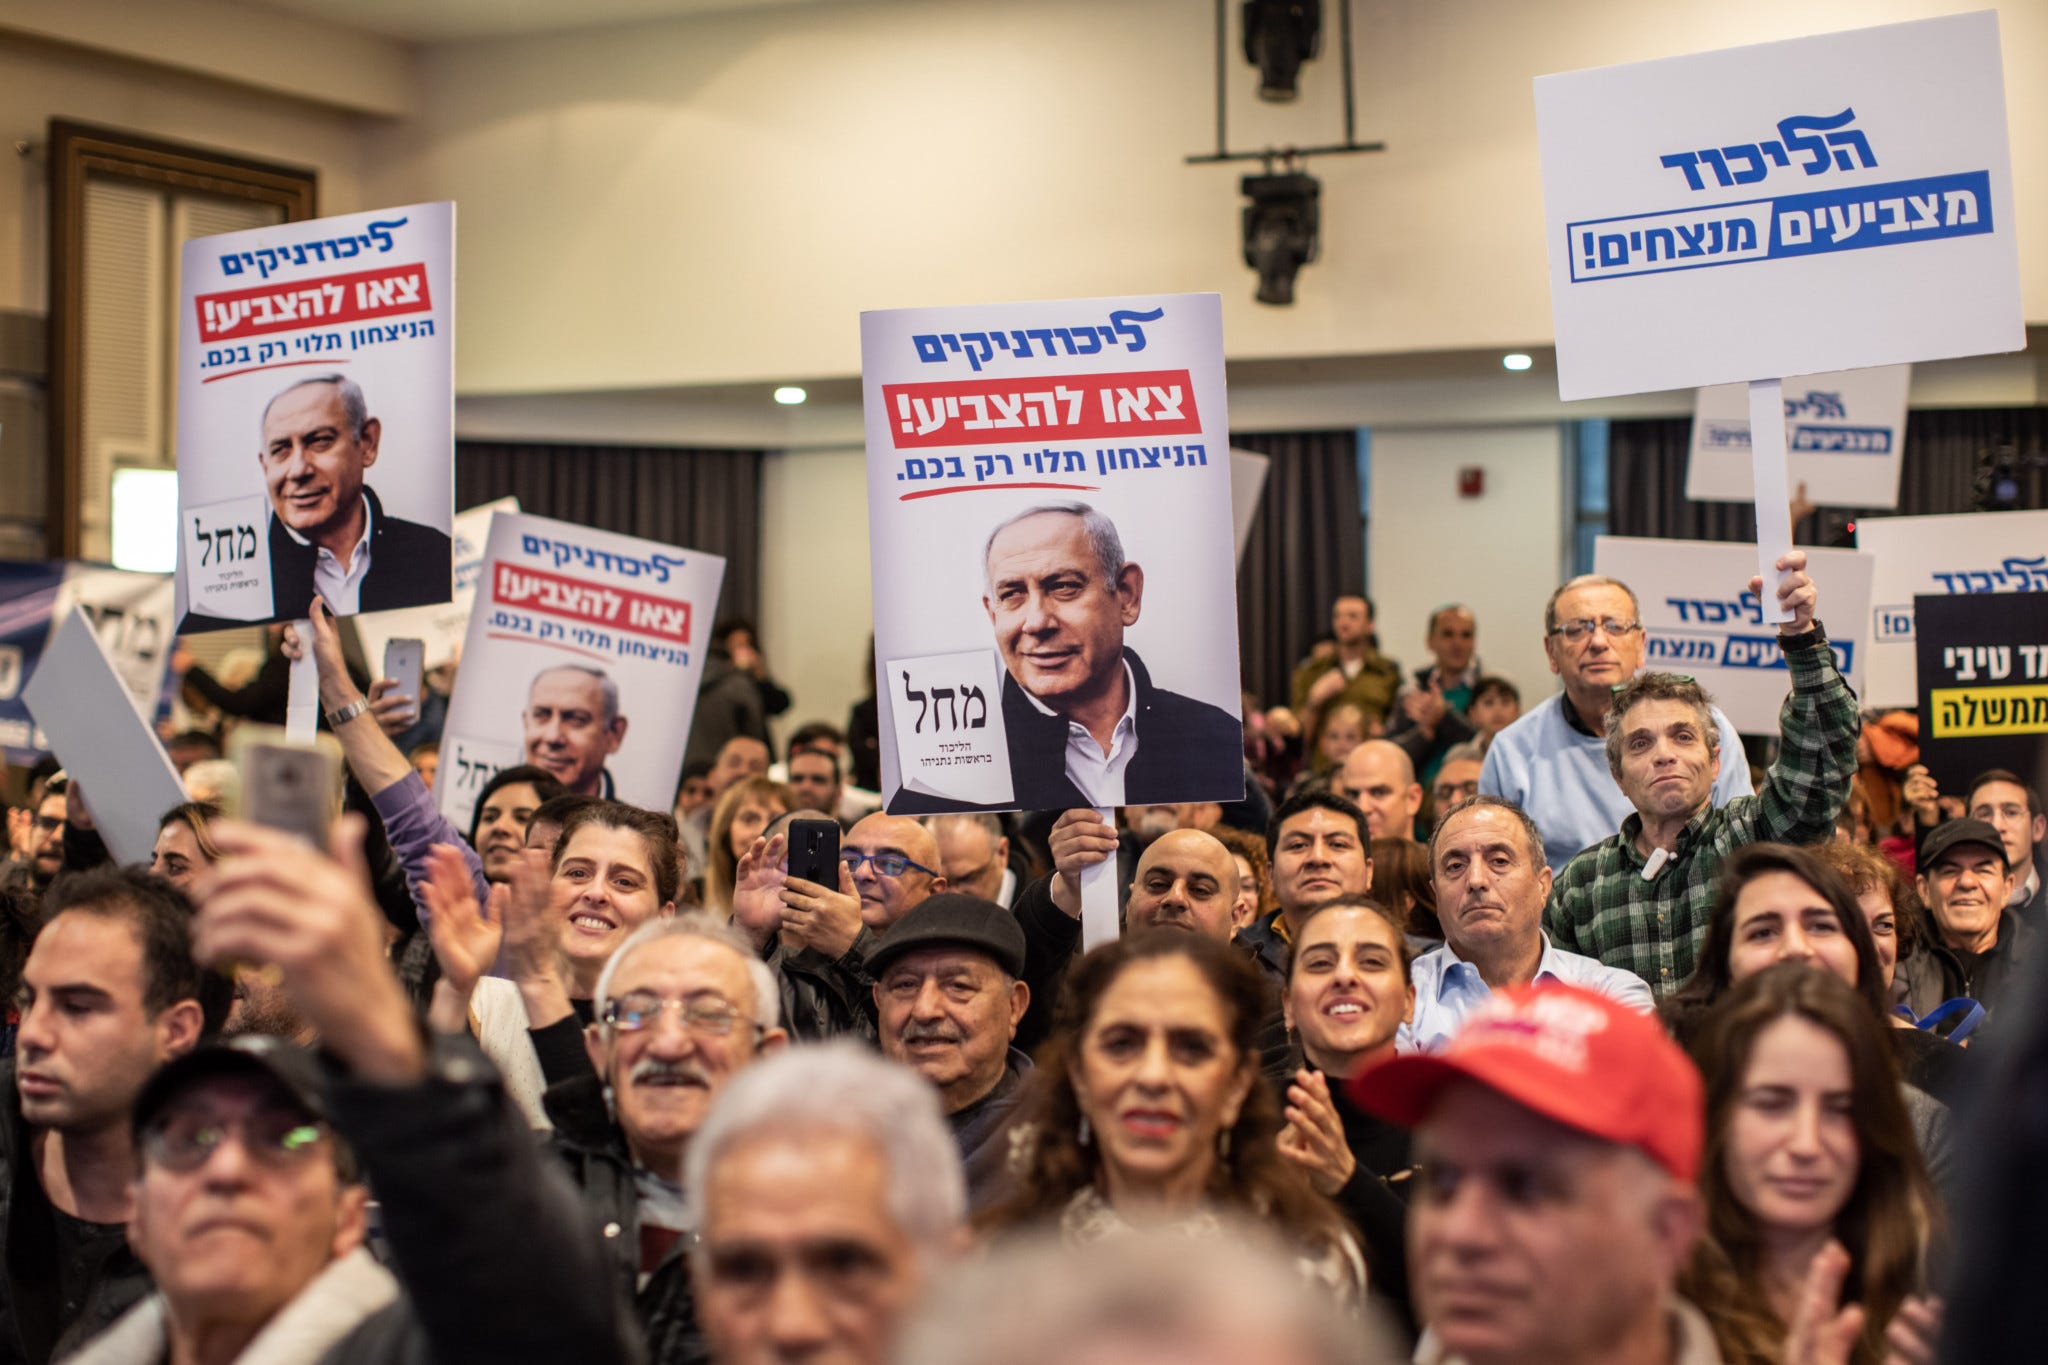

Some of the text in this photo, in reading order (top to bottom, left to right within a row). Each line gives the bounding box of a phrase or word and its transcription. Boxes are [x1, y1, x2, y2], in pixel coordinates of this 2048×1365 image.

[1659, 106, 1878, 191] הליכוד
[219, 216, 408, 278] ליכודניקים
[1583, 189, 1979, 269] מצביעים מנצחים!
[204, 273, 421, 333] צאו להצביע!
[200, 319, 435, 369] הניצחון תלוי רק בכם.
[912, 307, 1164, 371] ליכודניקים
[896, 384, 1186, 436] צאו להצביע!
[897, 443, 1208, 482] הניצחון תלוי רק בכם.
[194, 517, 257, 567] מחל
[521, 533, 686, 584] ליכודניקים
[498, 567, 623, 620] להצביע!
[628, 599, 687, 635] צאו
[1666, 591, 1777, 625] ליכוד
[488, 610, 533, 633] בכם.
[538, 619, 564, 642] רק
[571, 627, 611, 650] תלוי
[617, 638, 690, 667] הניצחון
[1944, 646, 2011, 681] טיבי
[902, 670, 987, 734] מחל
[457, 745, 497, 789] חל
[920, 753, 992, 767] בראשות נתניהו
[938, 741, 971, 753] הליכוד
